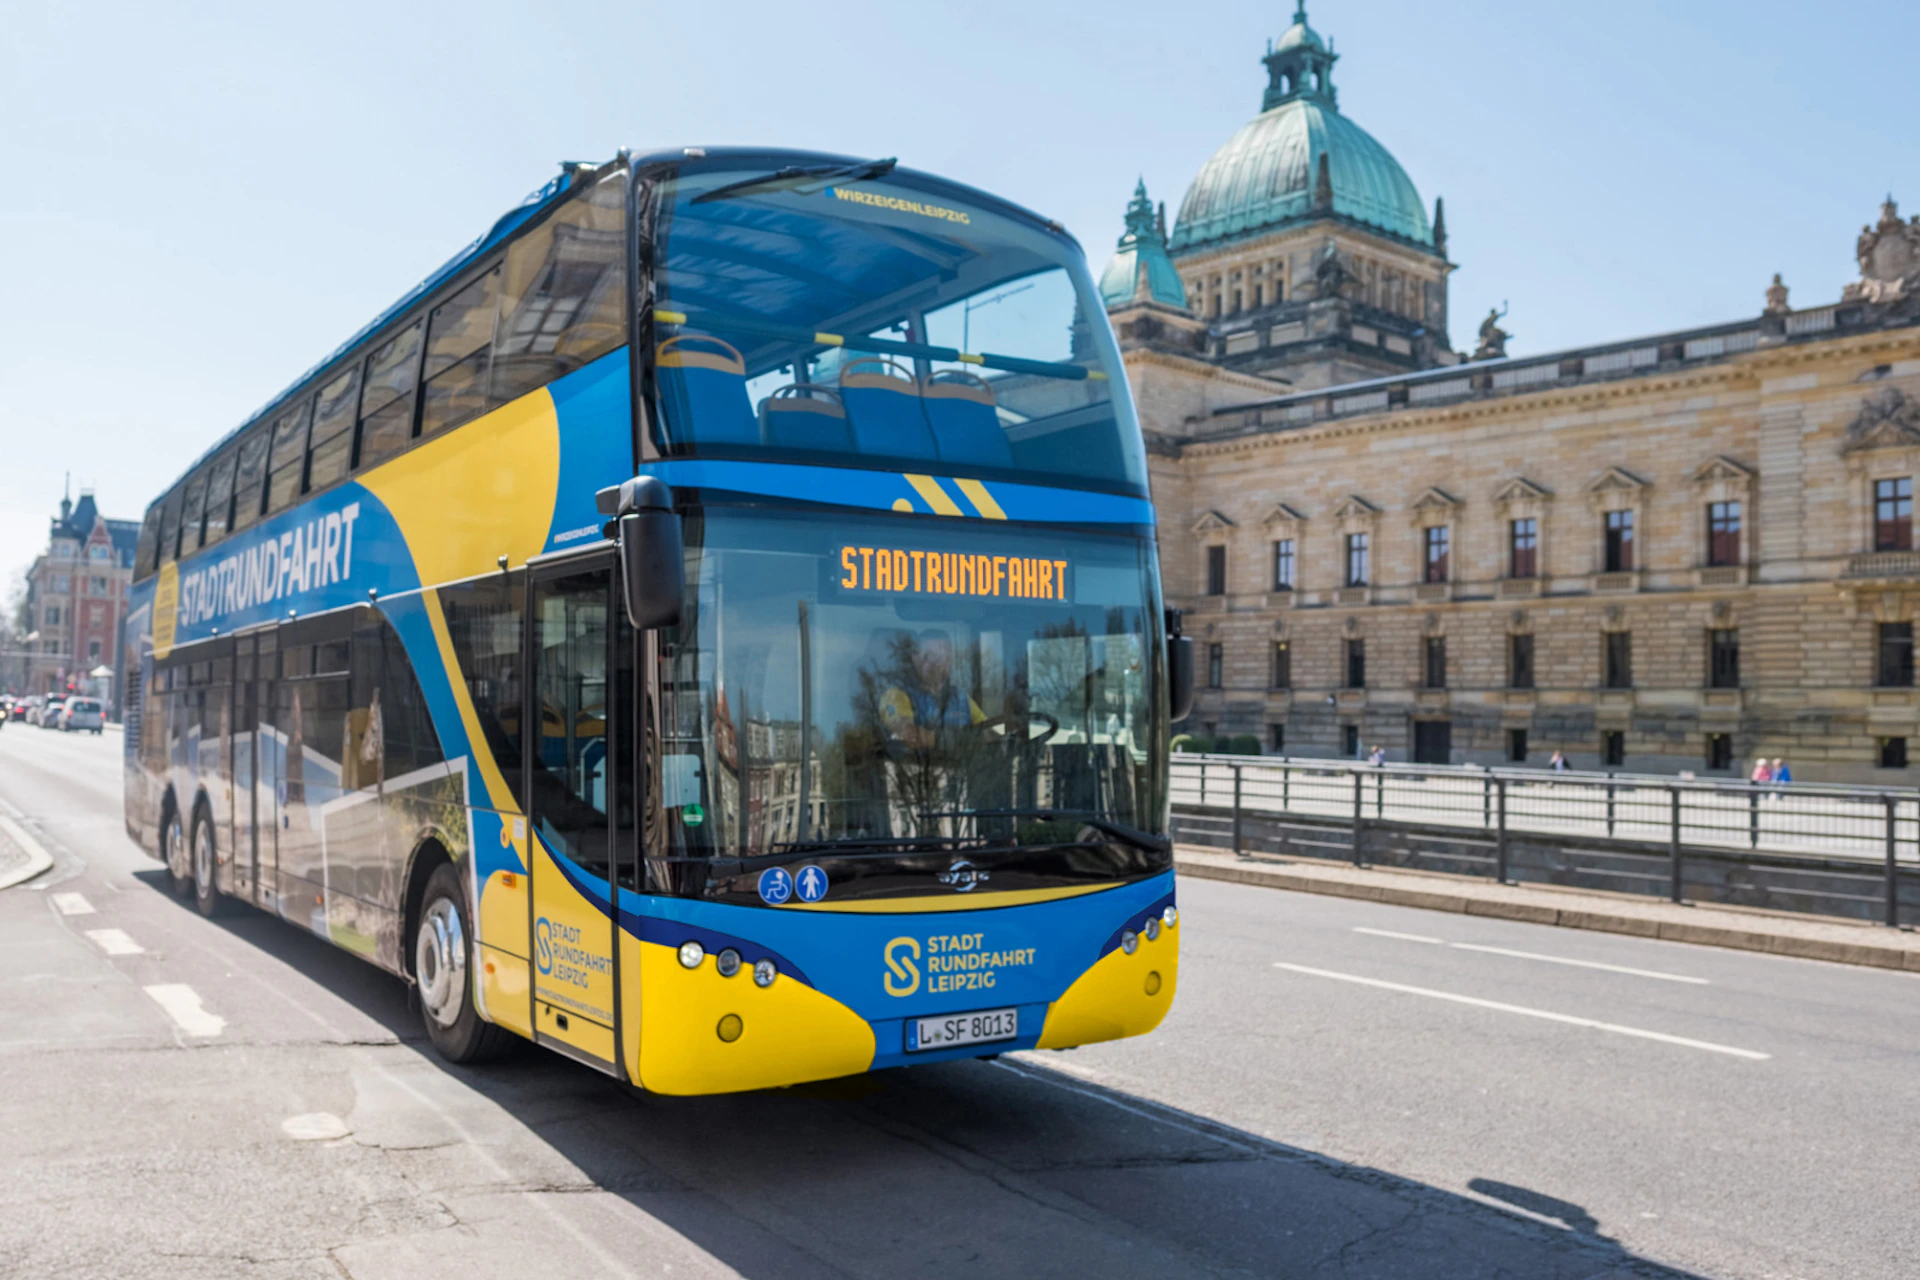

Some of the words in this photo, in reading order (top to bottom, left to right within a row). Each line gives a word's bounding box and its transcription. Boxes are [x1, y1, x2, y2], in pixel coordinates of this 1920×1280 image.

[180, 502, 360, 627] STADTRUNDFAHRT
[841, 546, 1067, 600] STADTRUNDFAHRT
[551, 922, 581, 944] STADT
[928, 933, 984, 953] STADT
[553, 943, 612, 975] RUNDFAHRT
[928, 948, 1036, 973] RUNDFAHRT
[553, 963, 588, 989] LEIPZIG
[928, 971, 996, 993] LEIPZIG
[945, 1018, 967, 1041] SF
[971, 1013, 1014, 1038] 8013
